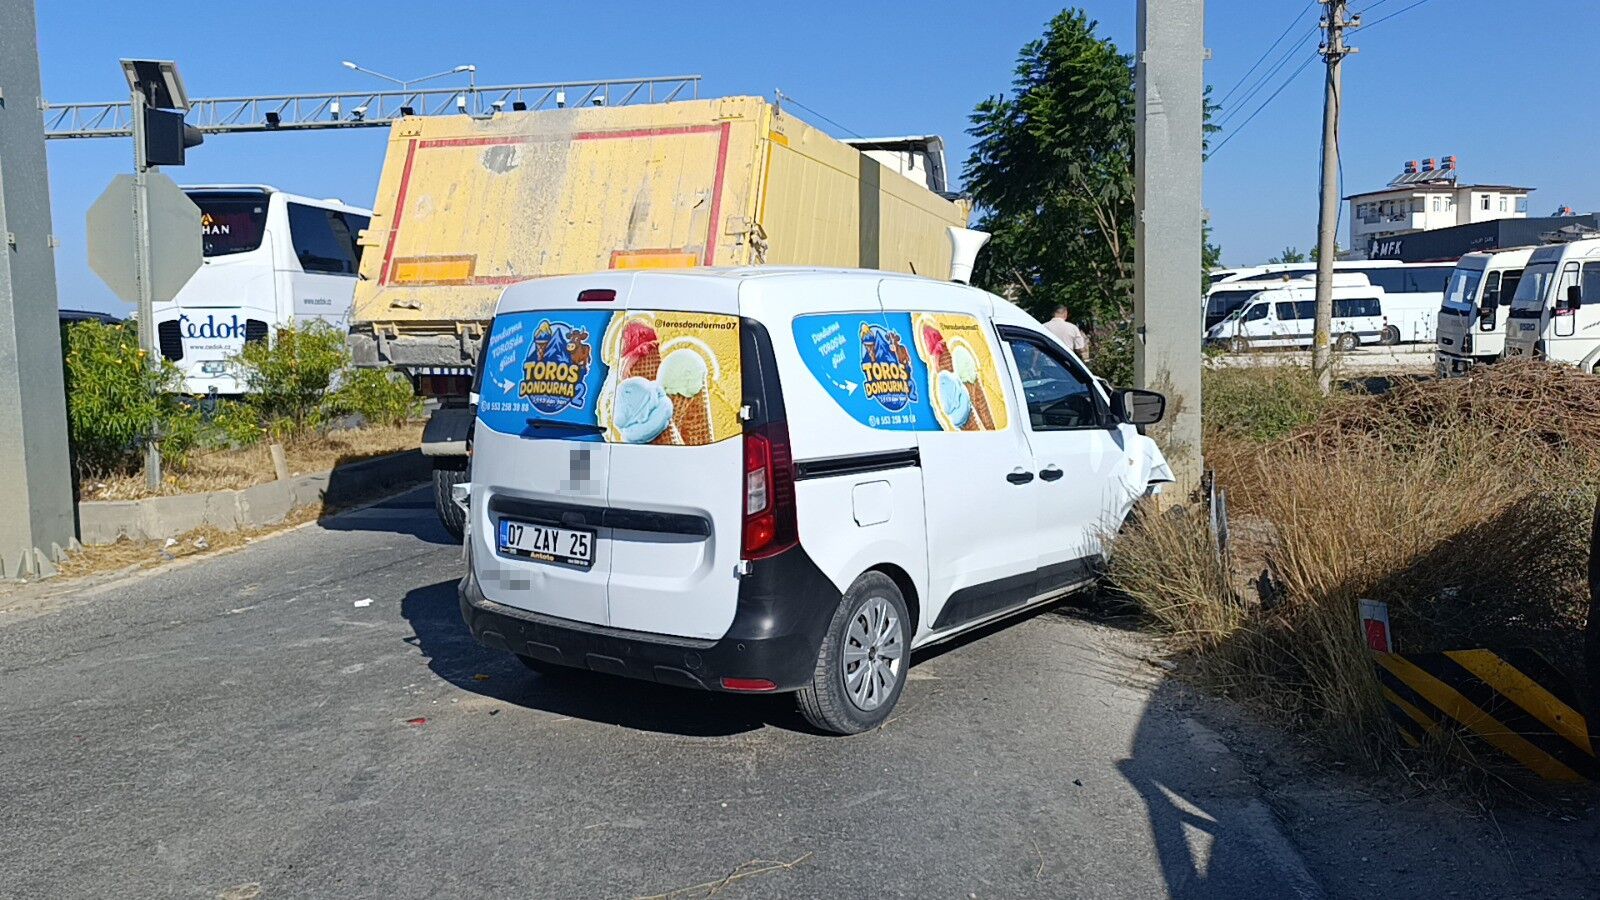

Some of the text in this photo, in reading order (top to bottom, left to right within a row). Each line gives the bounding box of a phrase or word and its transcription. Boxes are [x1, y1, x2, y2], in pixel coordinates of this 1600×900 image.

[1380, 240, 1402, 256] MFK
[523, 361, 579, 383] TOROS
[862, 362, 908, 381] TOROS
[520, 380, 574, 397] DONDURMA
[865, 380, 909, 396] DONDURMA
[508, 524, 588, 557] 07 ZAY 25
